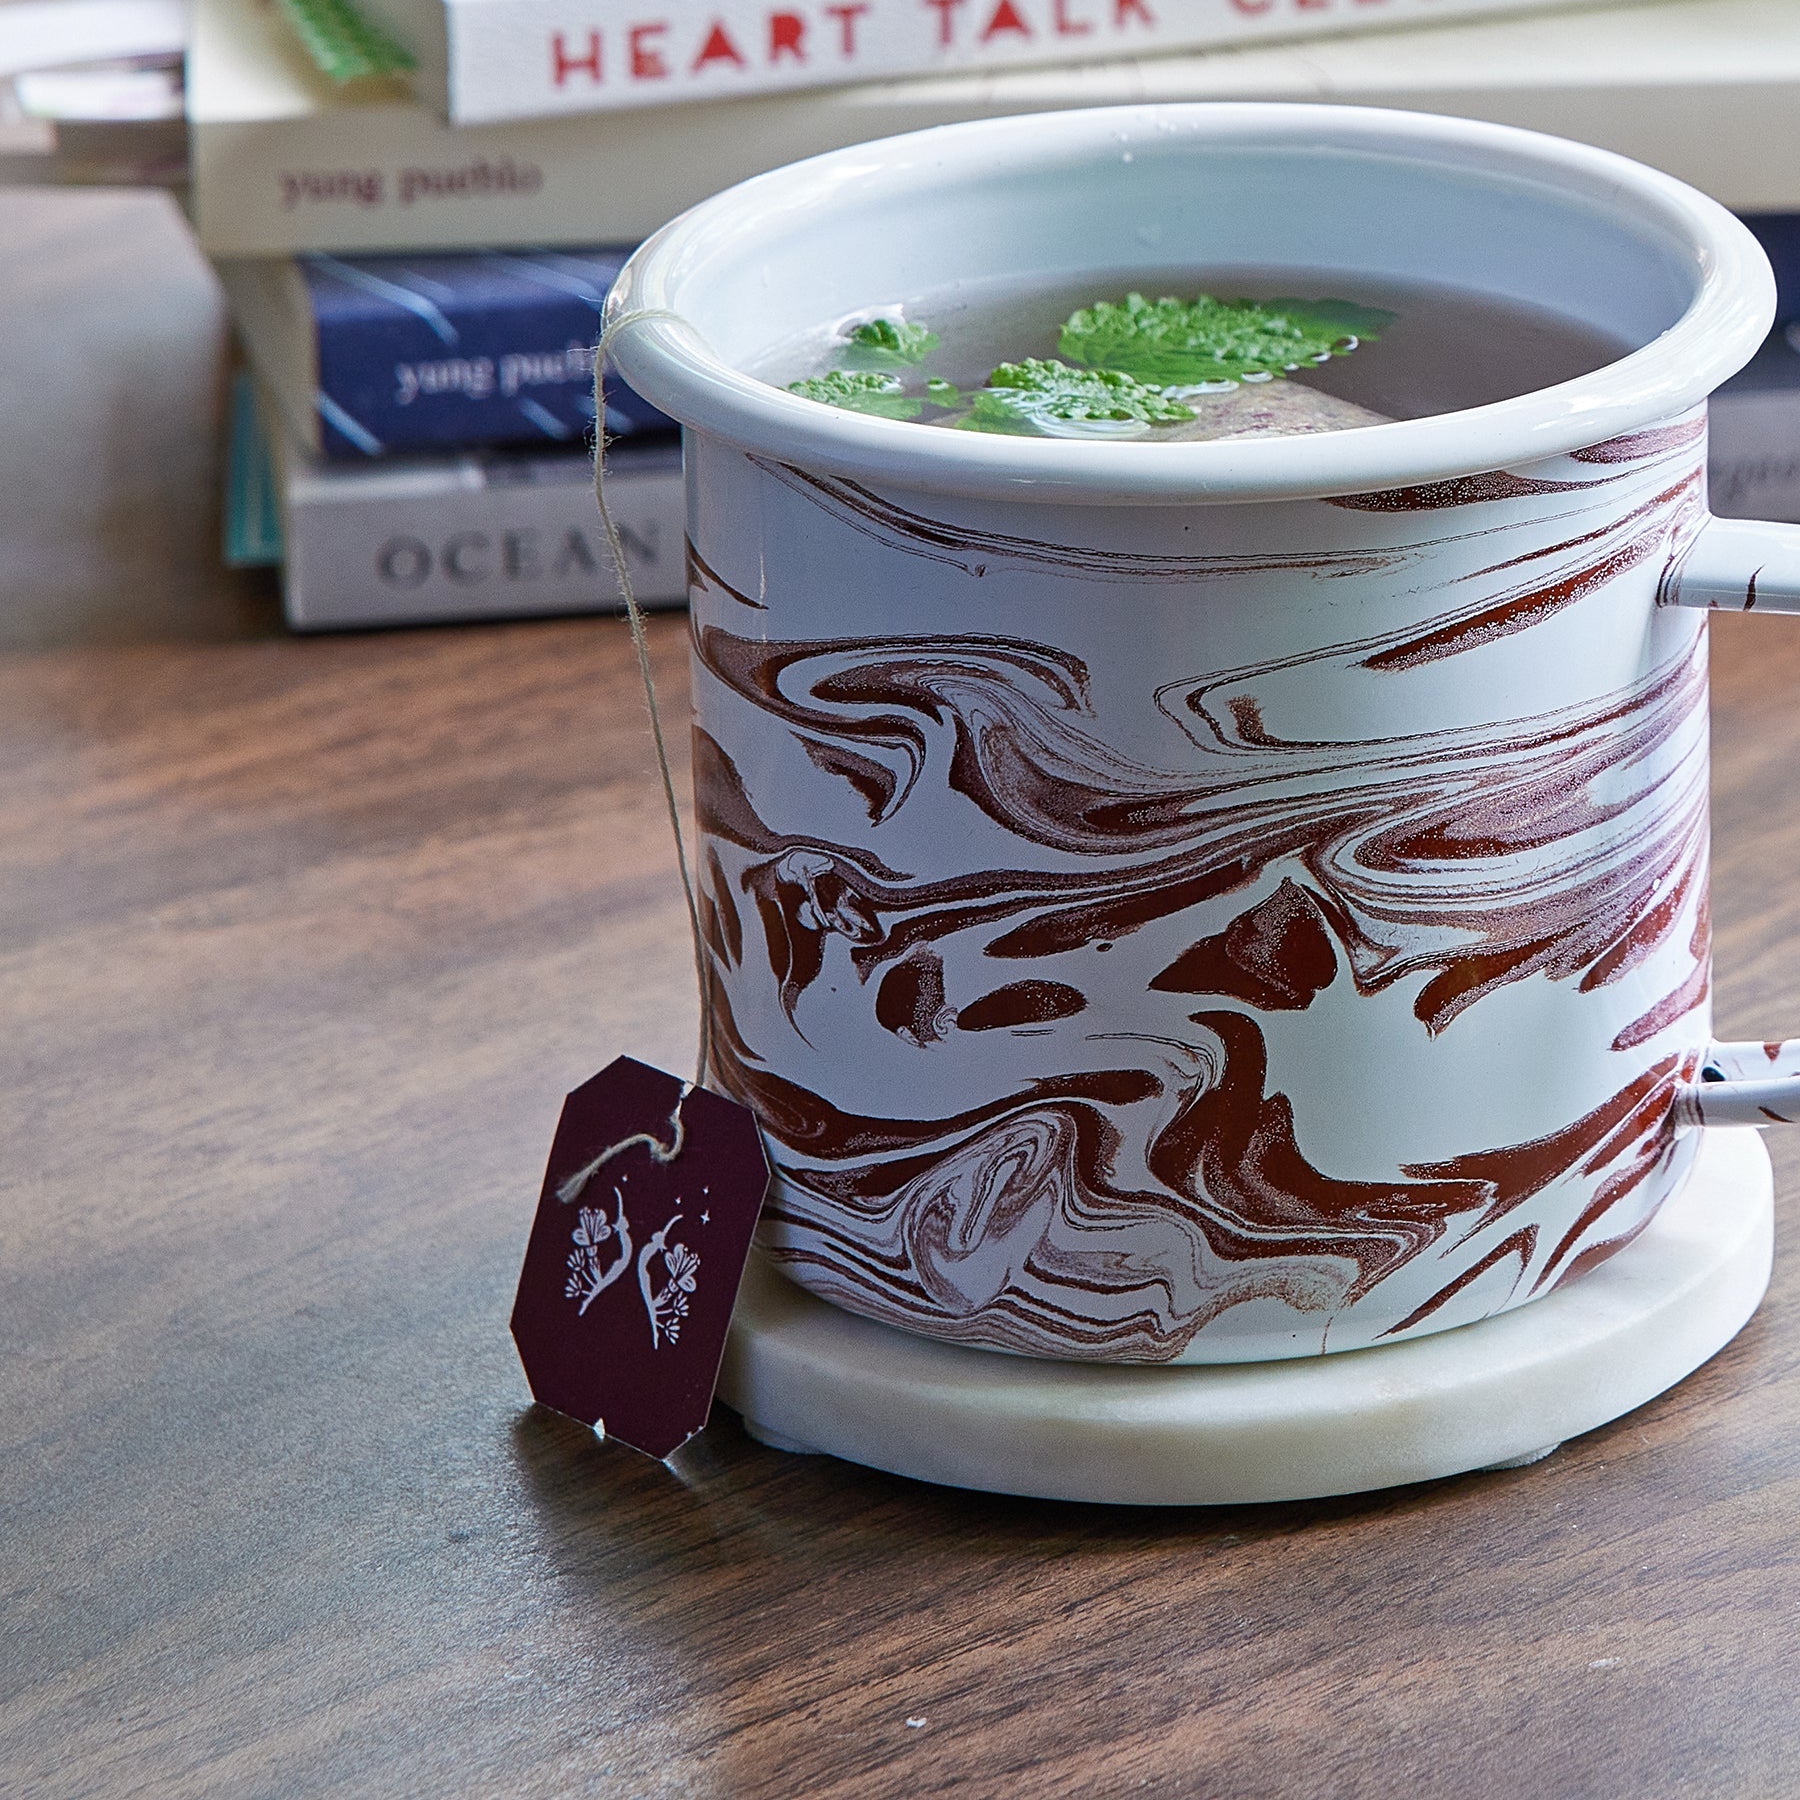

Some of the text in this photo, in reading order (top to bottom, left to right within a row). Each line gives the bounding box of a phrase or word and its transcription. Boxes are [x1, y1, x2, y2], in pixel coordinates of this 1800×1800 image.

[551, 0, 873, 88] HEART
[278, 155, 546, 212] yung pueblo
[394, 355, 496, 406] yung
[373, 522, 661, 590] OCEAN
